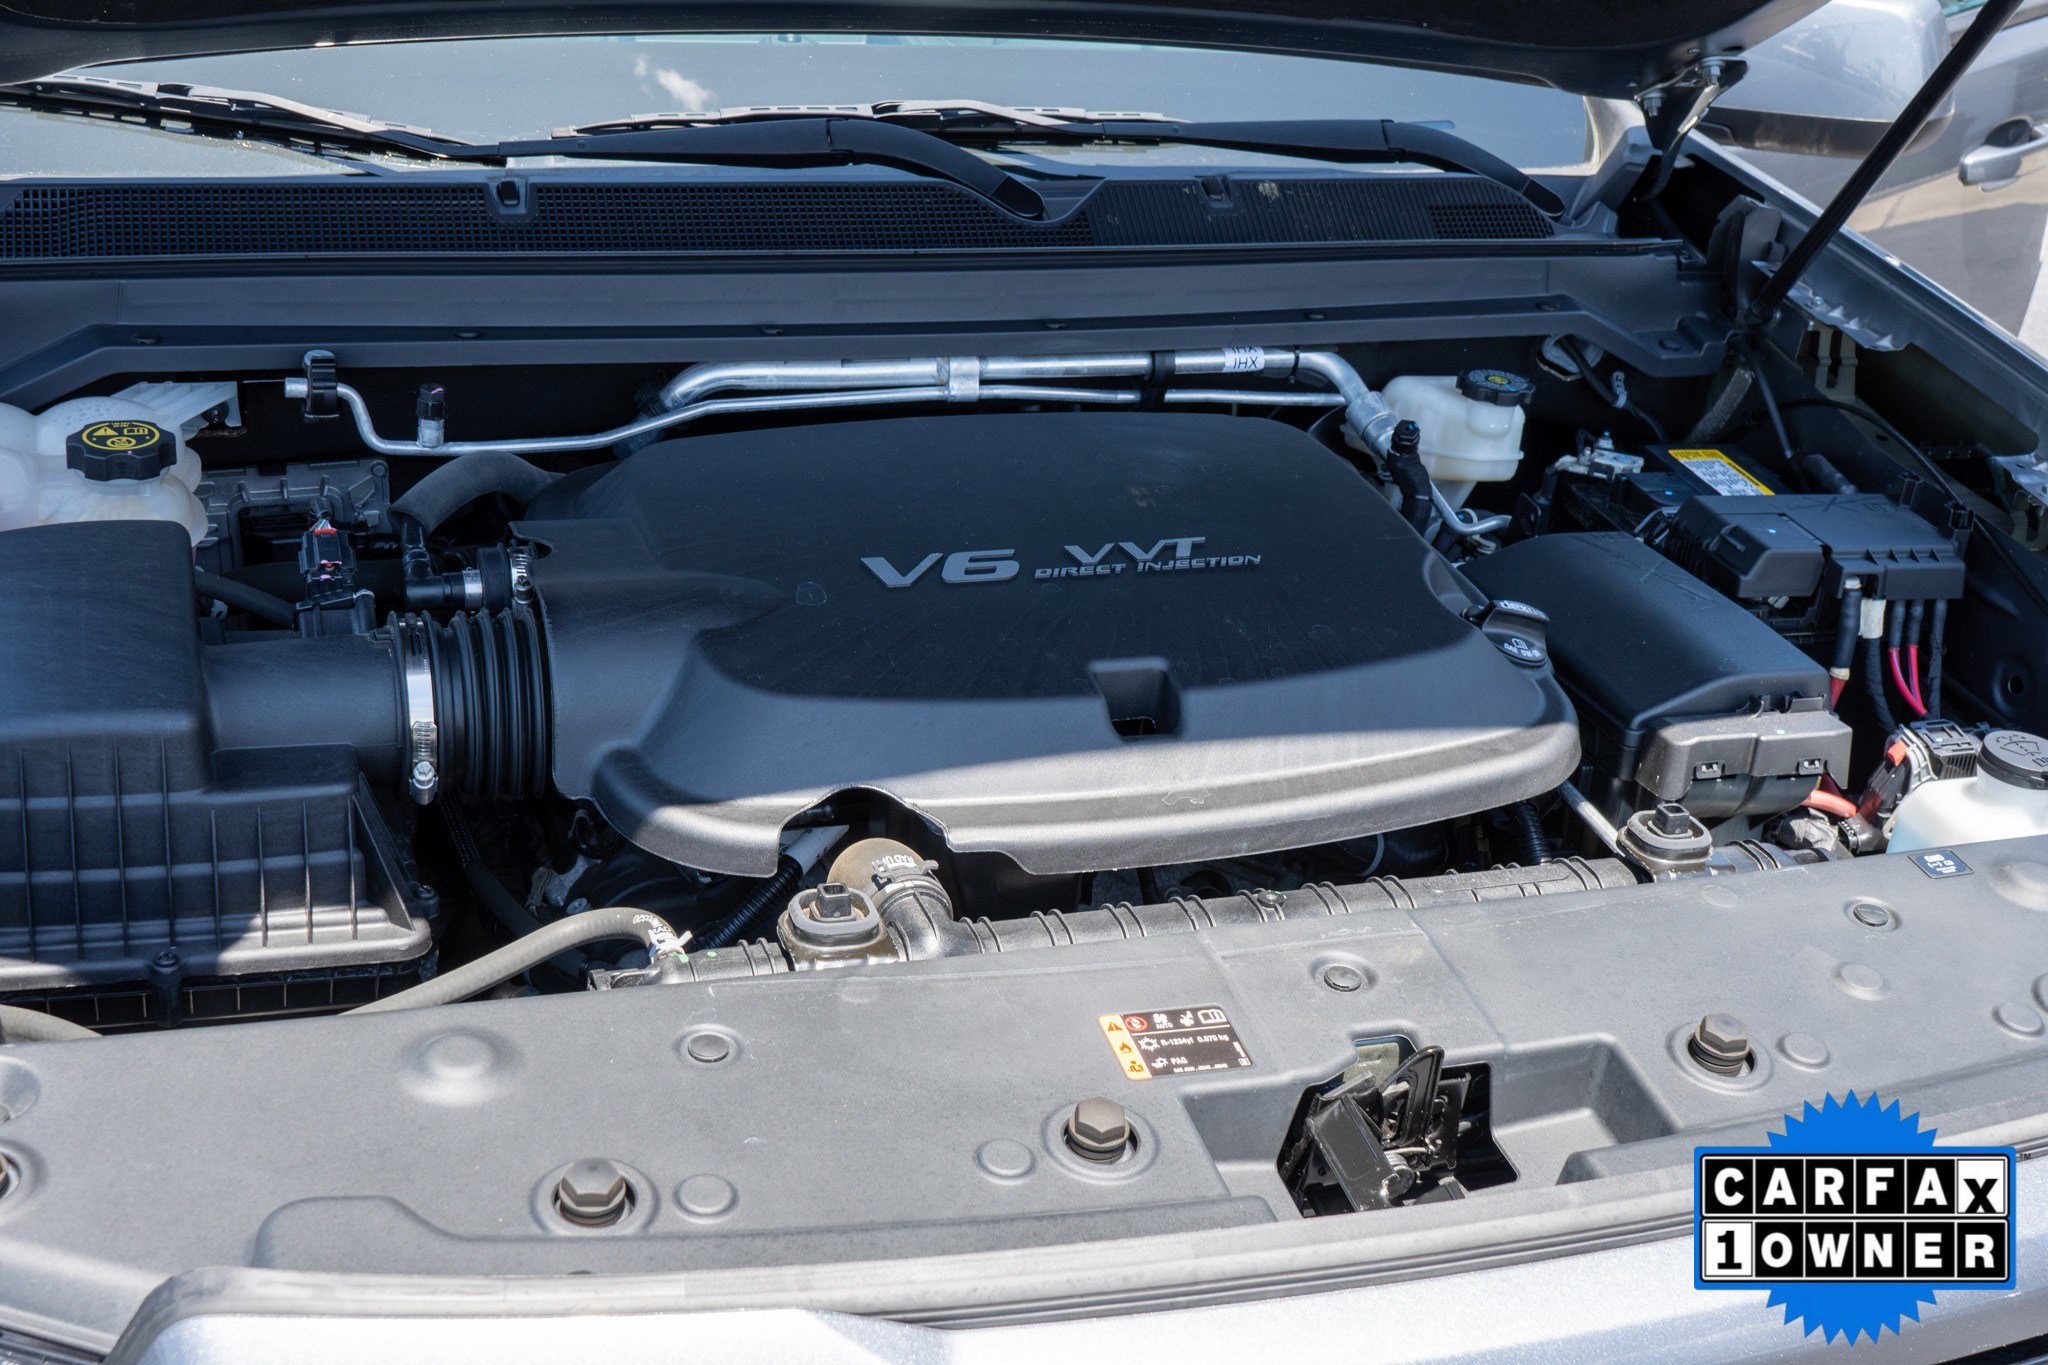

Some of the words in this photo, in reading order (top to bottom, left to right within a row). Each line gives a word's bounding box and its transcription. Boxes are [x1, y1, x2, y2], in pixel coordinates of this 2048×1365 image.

[1063, 535, 1207, 565] VVT
[860, 548, 1020, 588] V6
[1034, 563, 1127, 579] DIRECT
[1137, 554, 1262, 572] INJECTION
